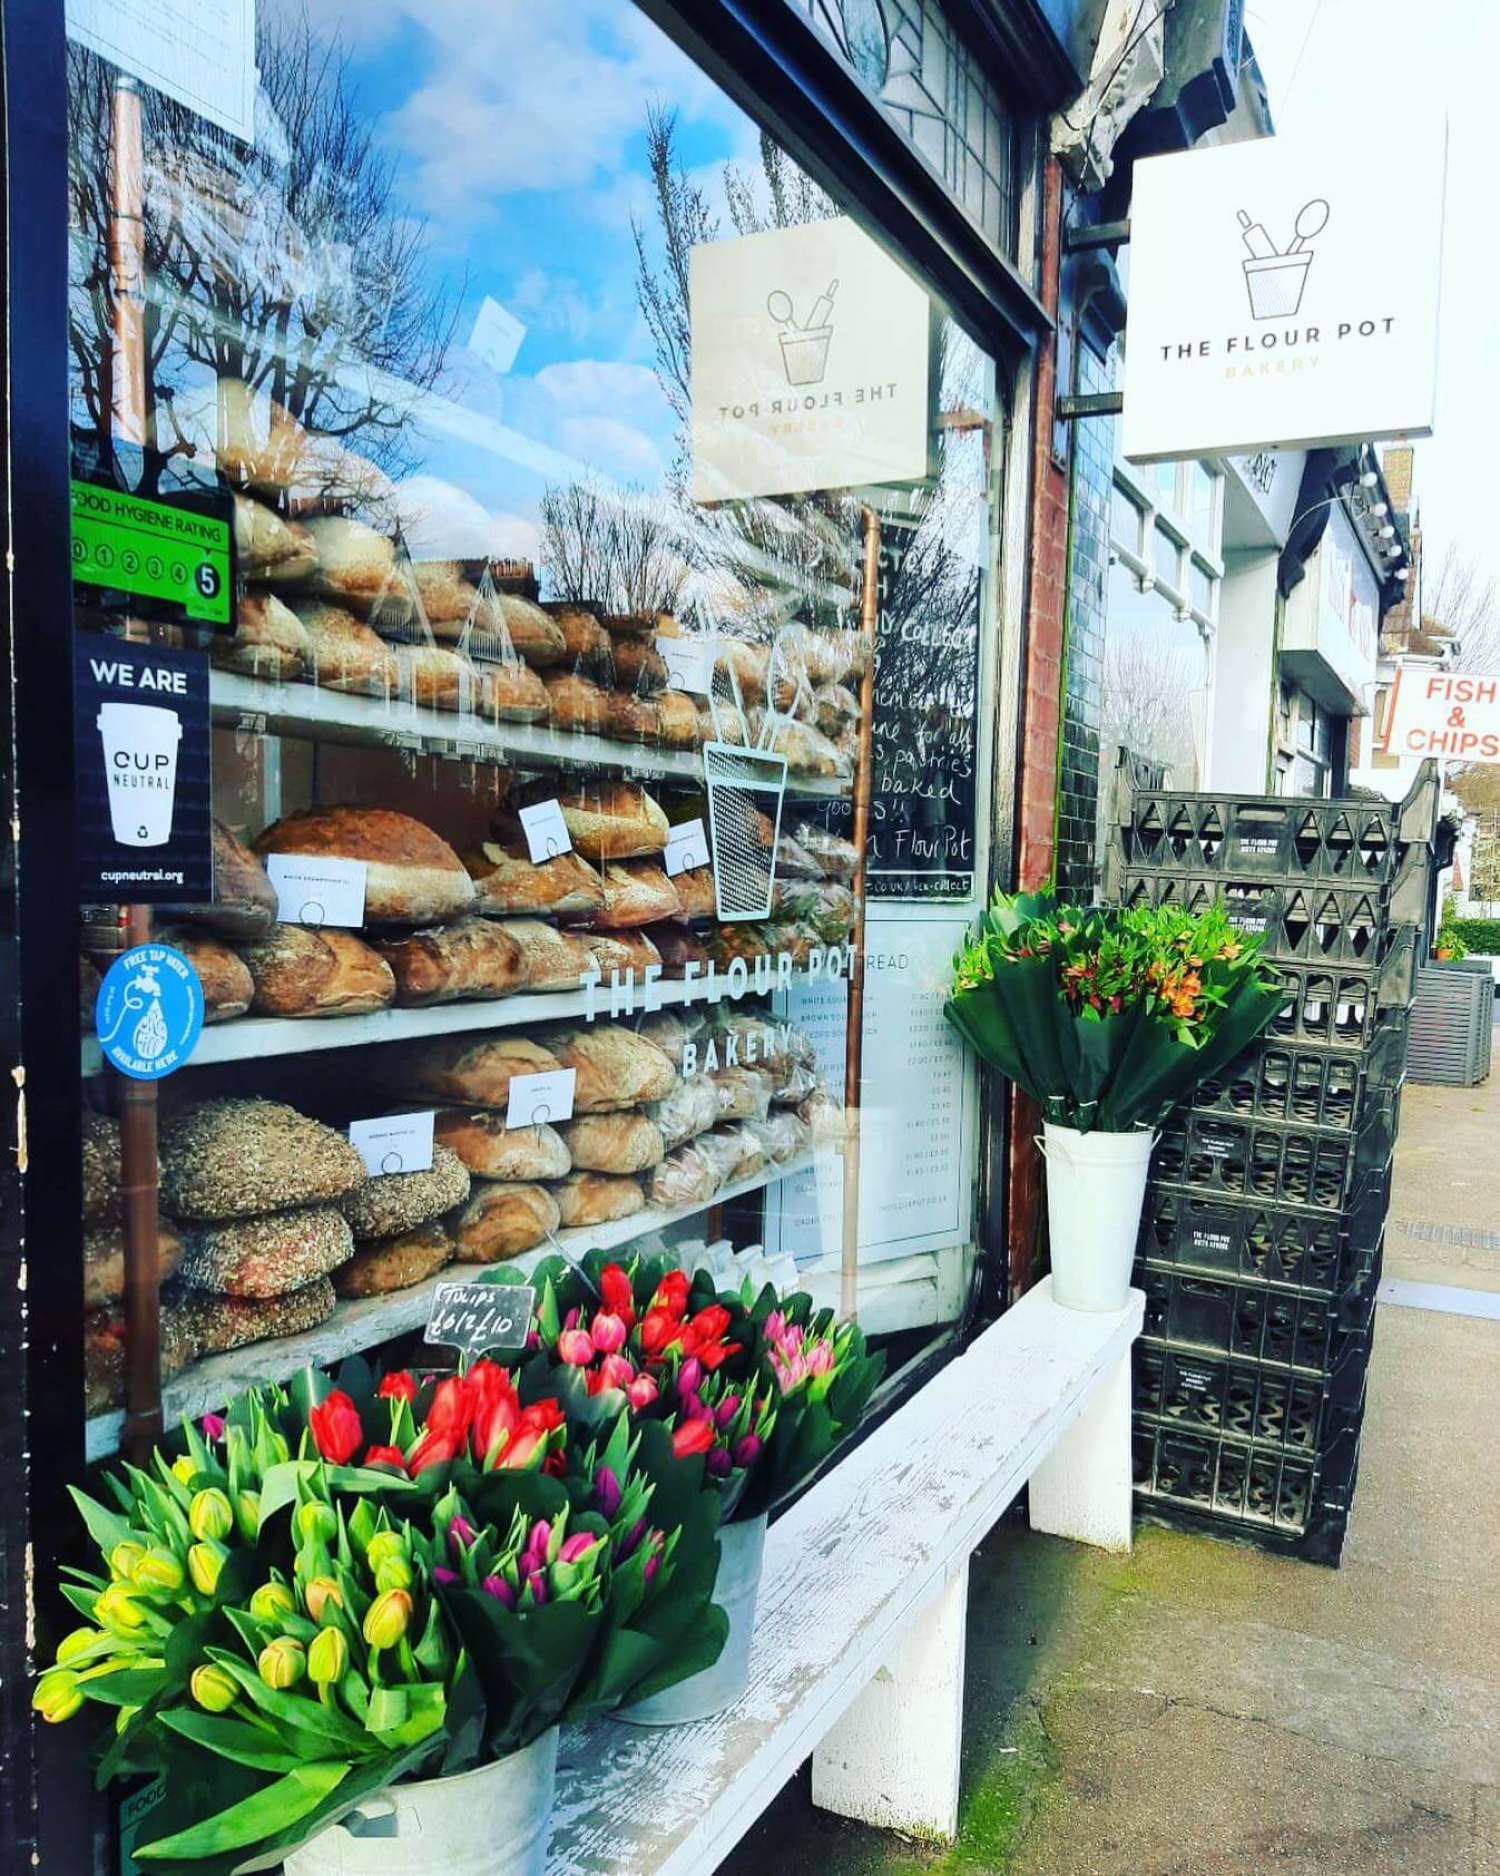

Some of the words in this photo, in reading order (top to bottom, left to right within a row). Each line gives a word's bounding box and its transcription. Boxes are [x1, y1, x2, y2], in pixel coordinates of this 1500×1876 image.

[1160, 340, 1211, 361] THE
[1226, 327, 1320, 353] FLOUR
[1337, 317, 1395, 340] POT
[1225, 355, 1320, 379] BAKERY
[115, 502, 175, 530] HYGIENE
[176, 520, 222, 543] RATING
[200, 565, 216, 596] 5
[89, 658, 134, 687] WE
[138, 667, 188, 695] ARE
[1426, 677, 1497, 704] FISH
[1446, 705, 1466, 728] &
[1406, 728, 1500, 757] CHIPS
[113, 750, 170, 772] CUP
[113, 773, 170, 791] NEUTRAL
[881, 768, 962, 805] baked
[817, 798, 906, 832] goos!!
[100, 868, 184, 885] cupneutral.org
[123, 949, 148, 971] FREE
[865, 953, 910, 970] READ
[579, 963, 663, 1021] THE
[684, 952, 793, 1007] FLOUR
[808, 944, 858, 987] POT
[683, 1023, 795, 1078] BAKERY
[442, 1288, 496, 1308] TULIPS
